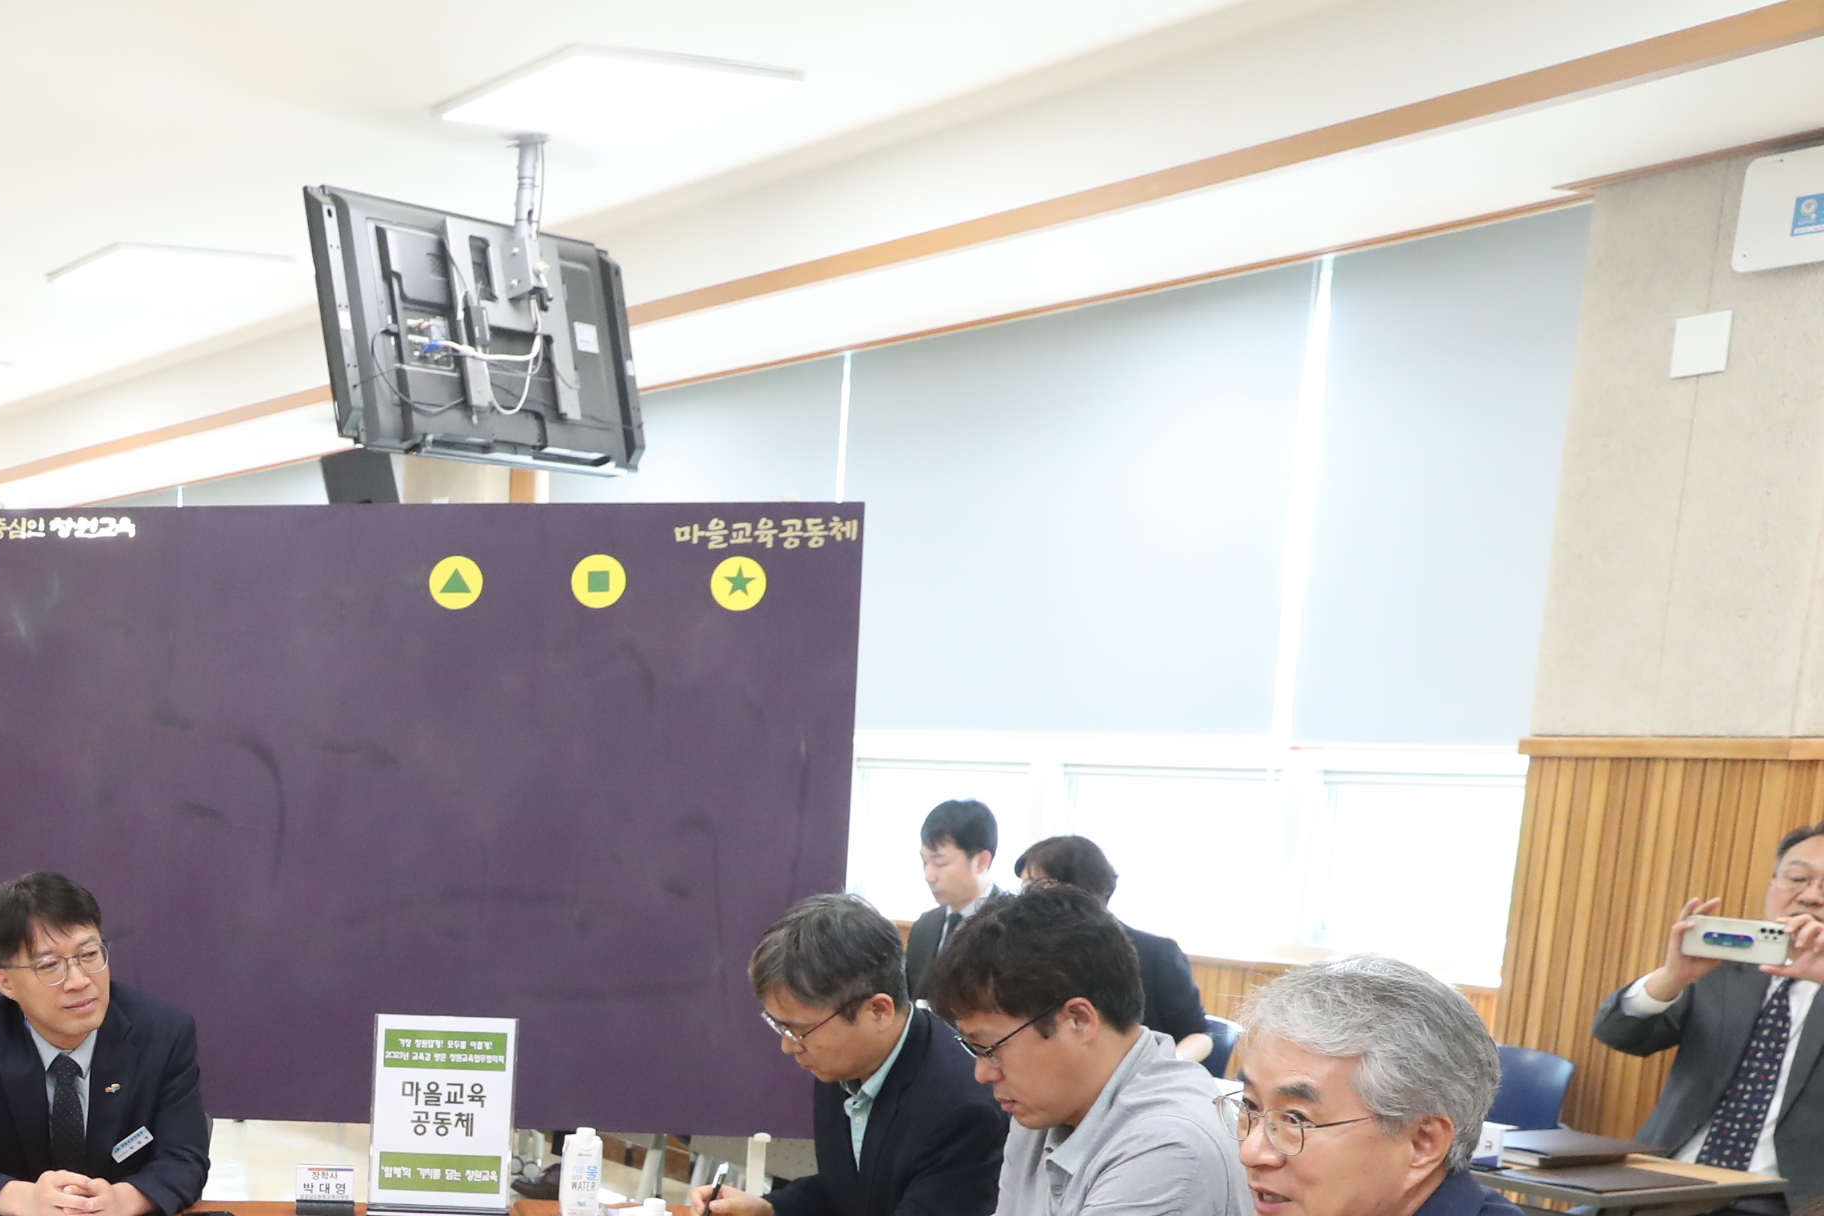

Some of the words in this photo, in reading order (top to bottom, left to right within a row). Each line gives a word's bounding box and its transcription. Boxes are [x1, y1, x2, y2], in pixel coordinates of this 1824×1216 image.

[674, 516, 858, 549] 마을교육공동체
[401, 1081, 487, 1108] 마을교육
[410, 1110, 474, 1137] 공동체
[312, 1171, 338, 1180] 장학사
[465, 1169, 498, 1182] 창원교육
[586, 1165, 598, 1181] 물
[571, 1181, 596, 1192] WATER
